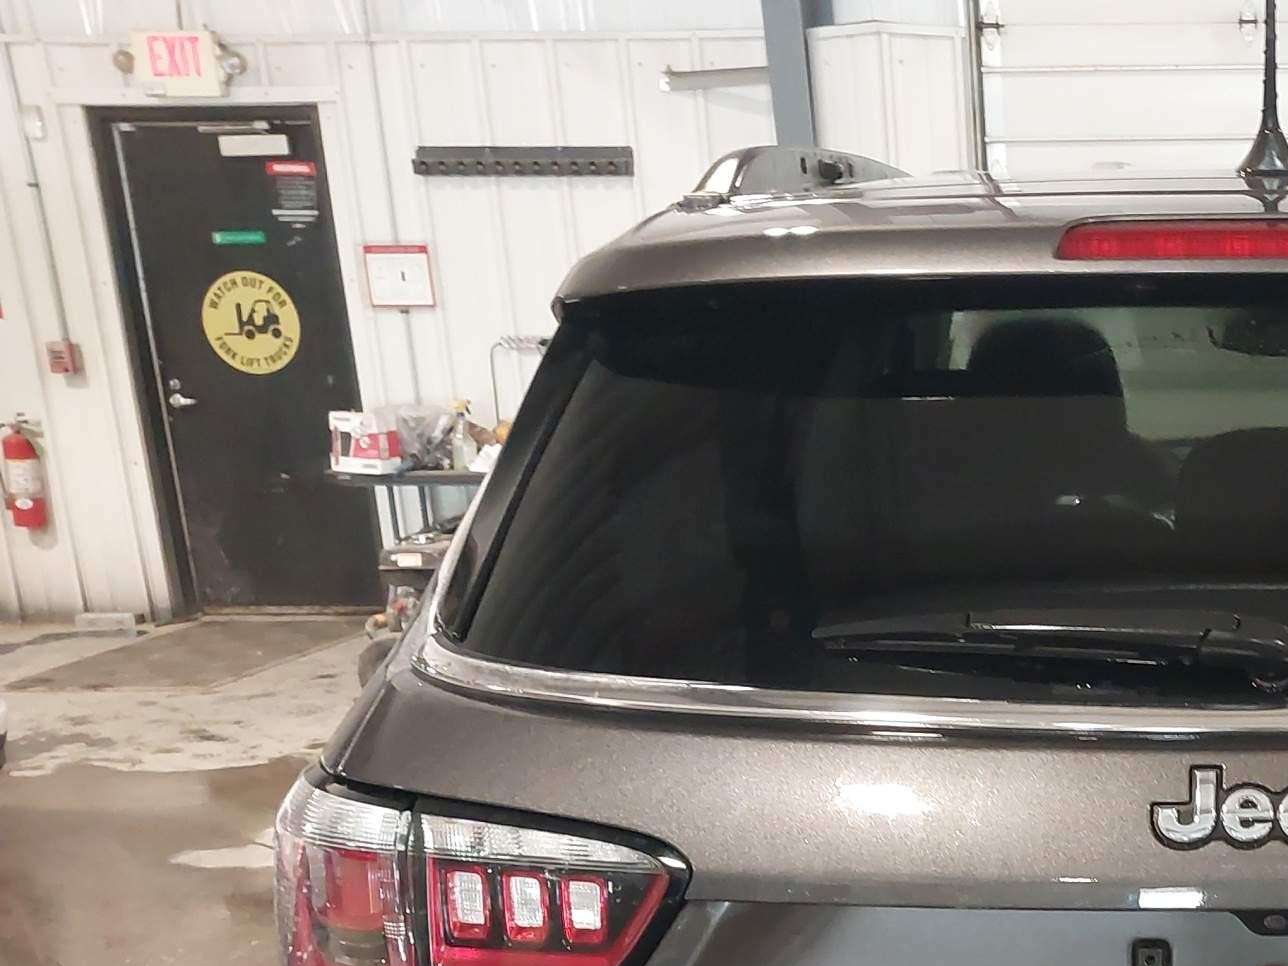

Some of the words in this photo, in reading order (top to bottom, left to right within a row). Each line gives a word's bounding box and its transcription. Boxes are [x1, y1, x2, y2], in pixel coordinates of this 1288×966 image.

[146, 35, 202, 78] EXIT
[208, 278, 239, 310] WATCH
[241, 276, 265, 290] OUT
[266, 286, 289, 309] FOR
[214, 336, 238, 361] FORK
[240, 356, 262, 367] LIFT
[264, 335, 294, 368] TRUCKS
